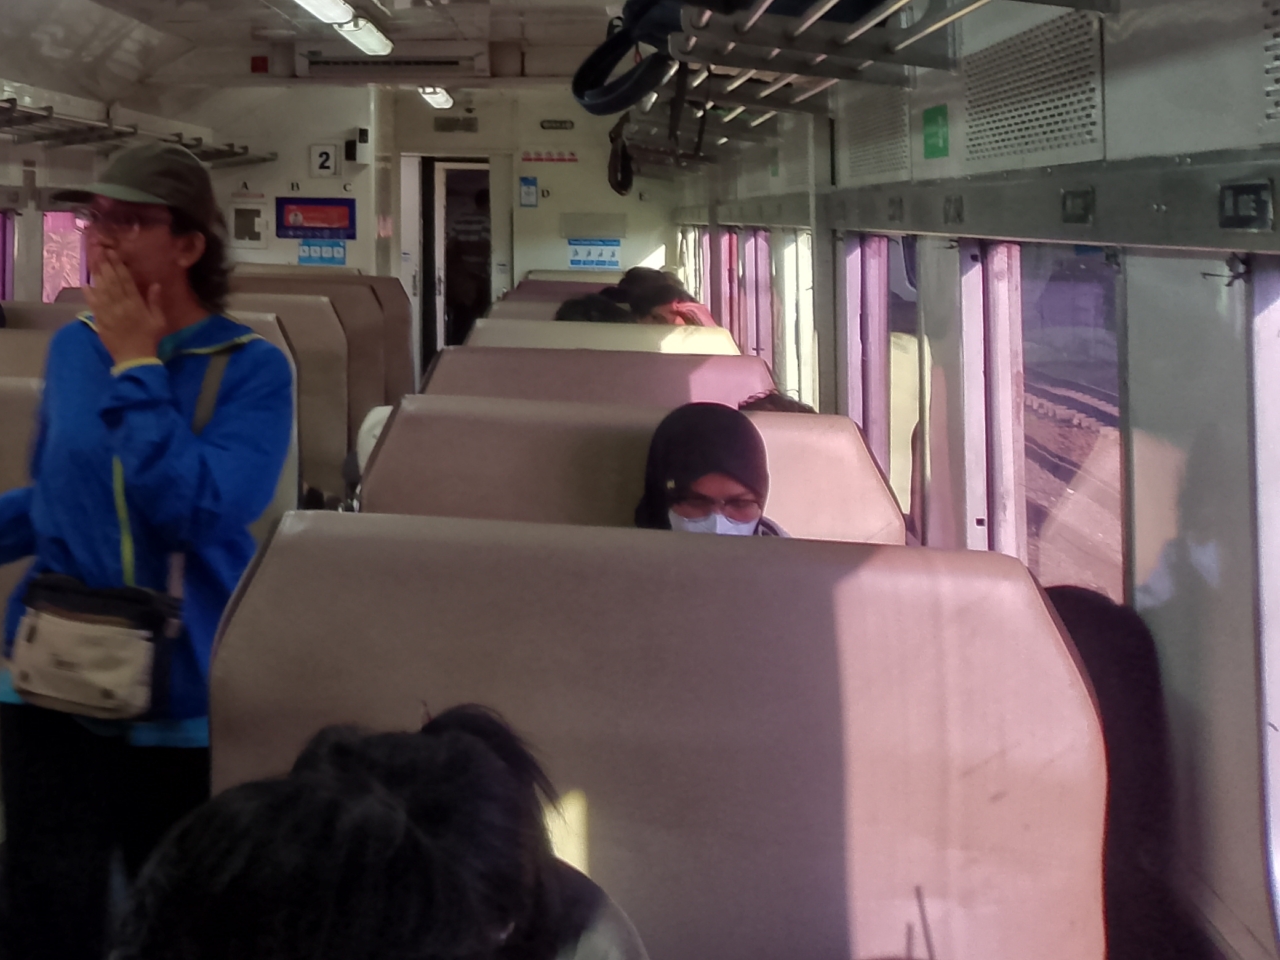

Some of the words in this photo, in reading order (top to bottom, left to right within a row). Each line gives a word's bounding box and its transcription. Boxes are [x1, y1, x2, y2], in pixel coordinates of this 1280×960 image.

[318, 151, 331, 170] 2
[240, 181, 249, 191] A
[291, 182, 300, 191] B
[343, 183, 352, 192] C
[541, 189, 550, 198] D
